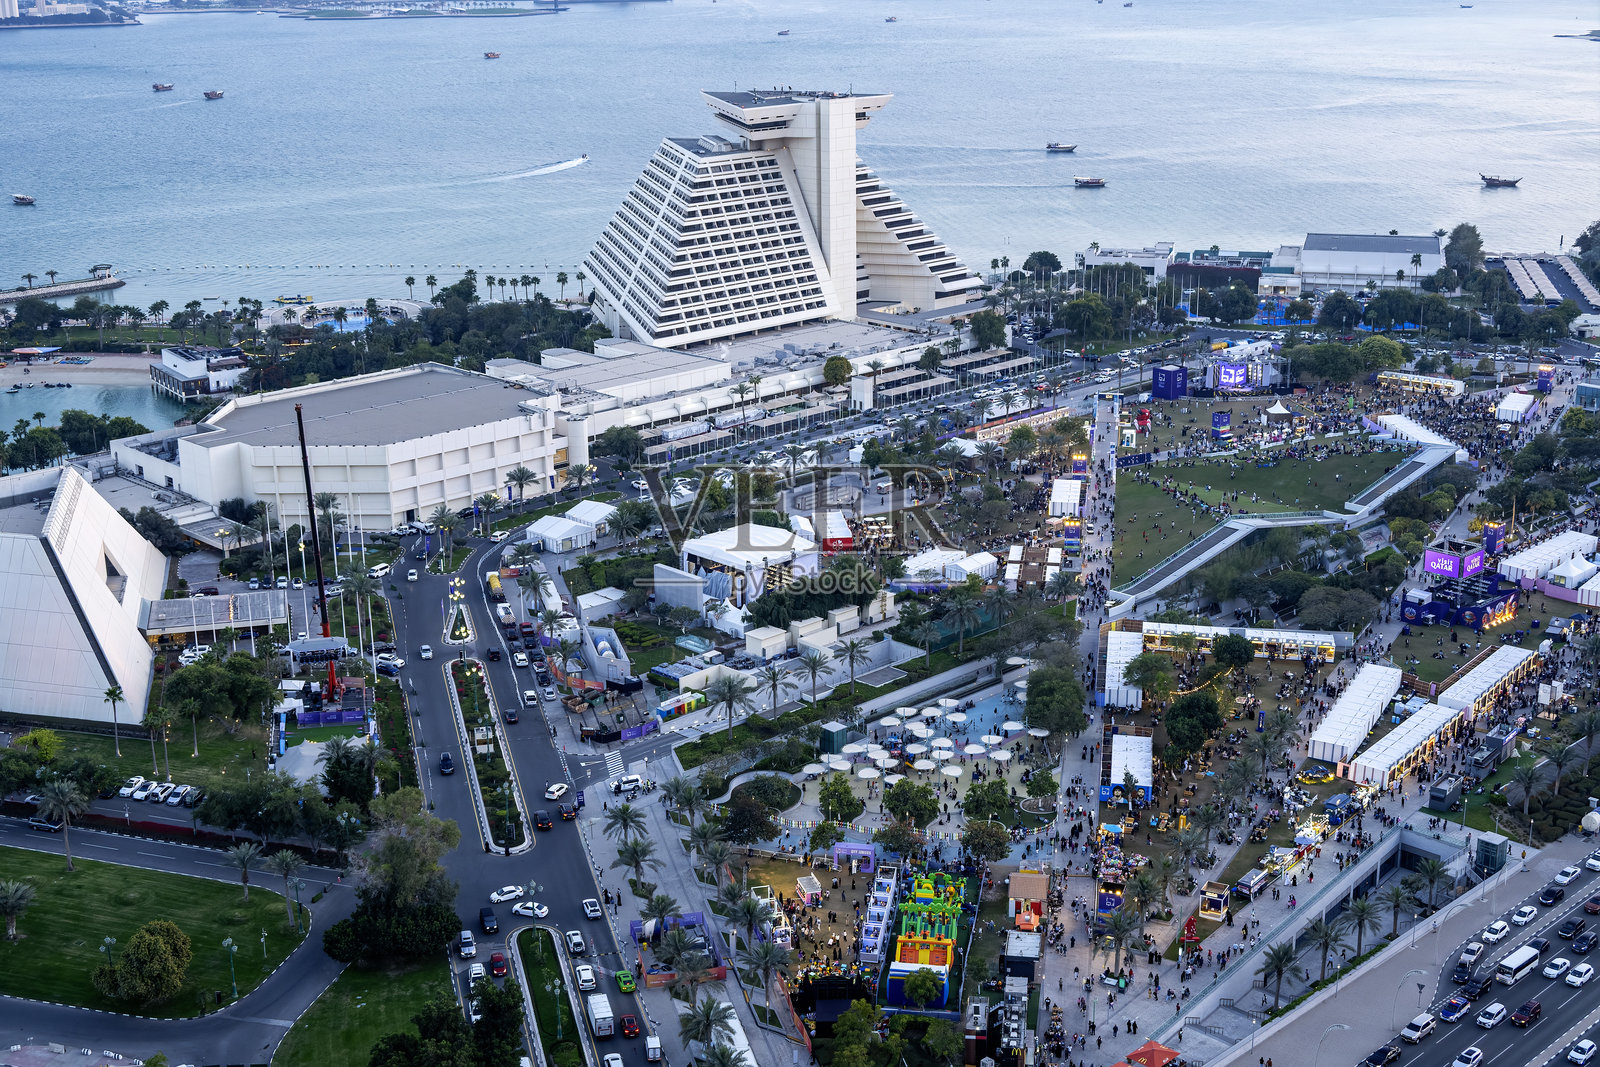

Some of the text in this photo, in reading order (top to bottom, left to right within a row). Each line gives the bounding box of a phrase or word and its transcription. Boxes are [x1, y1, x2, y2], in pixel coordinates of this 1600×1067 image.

[1431, 561, 1453, 572] QATAR
[1438, 557, 1453, 566] visit
[1466, 561, 1481, 572] QATAR
